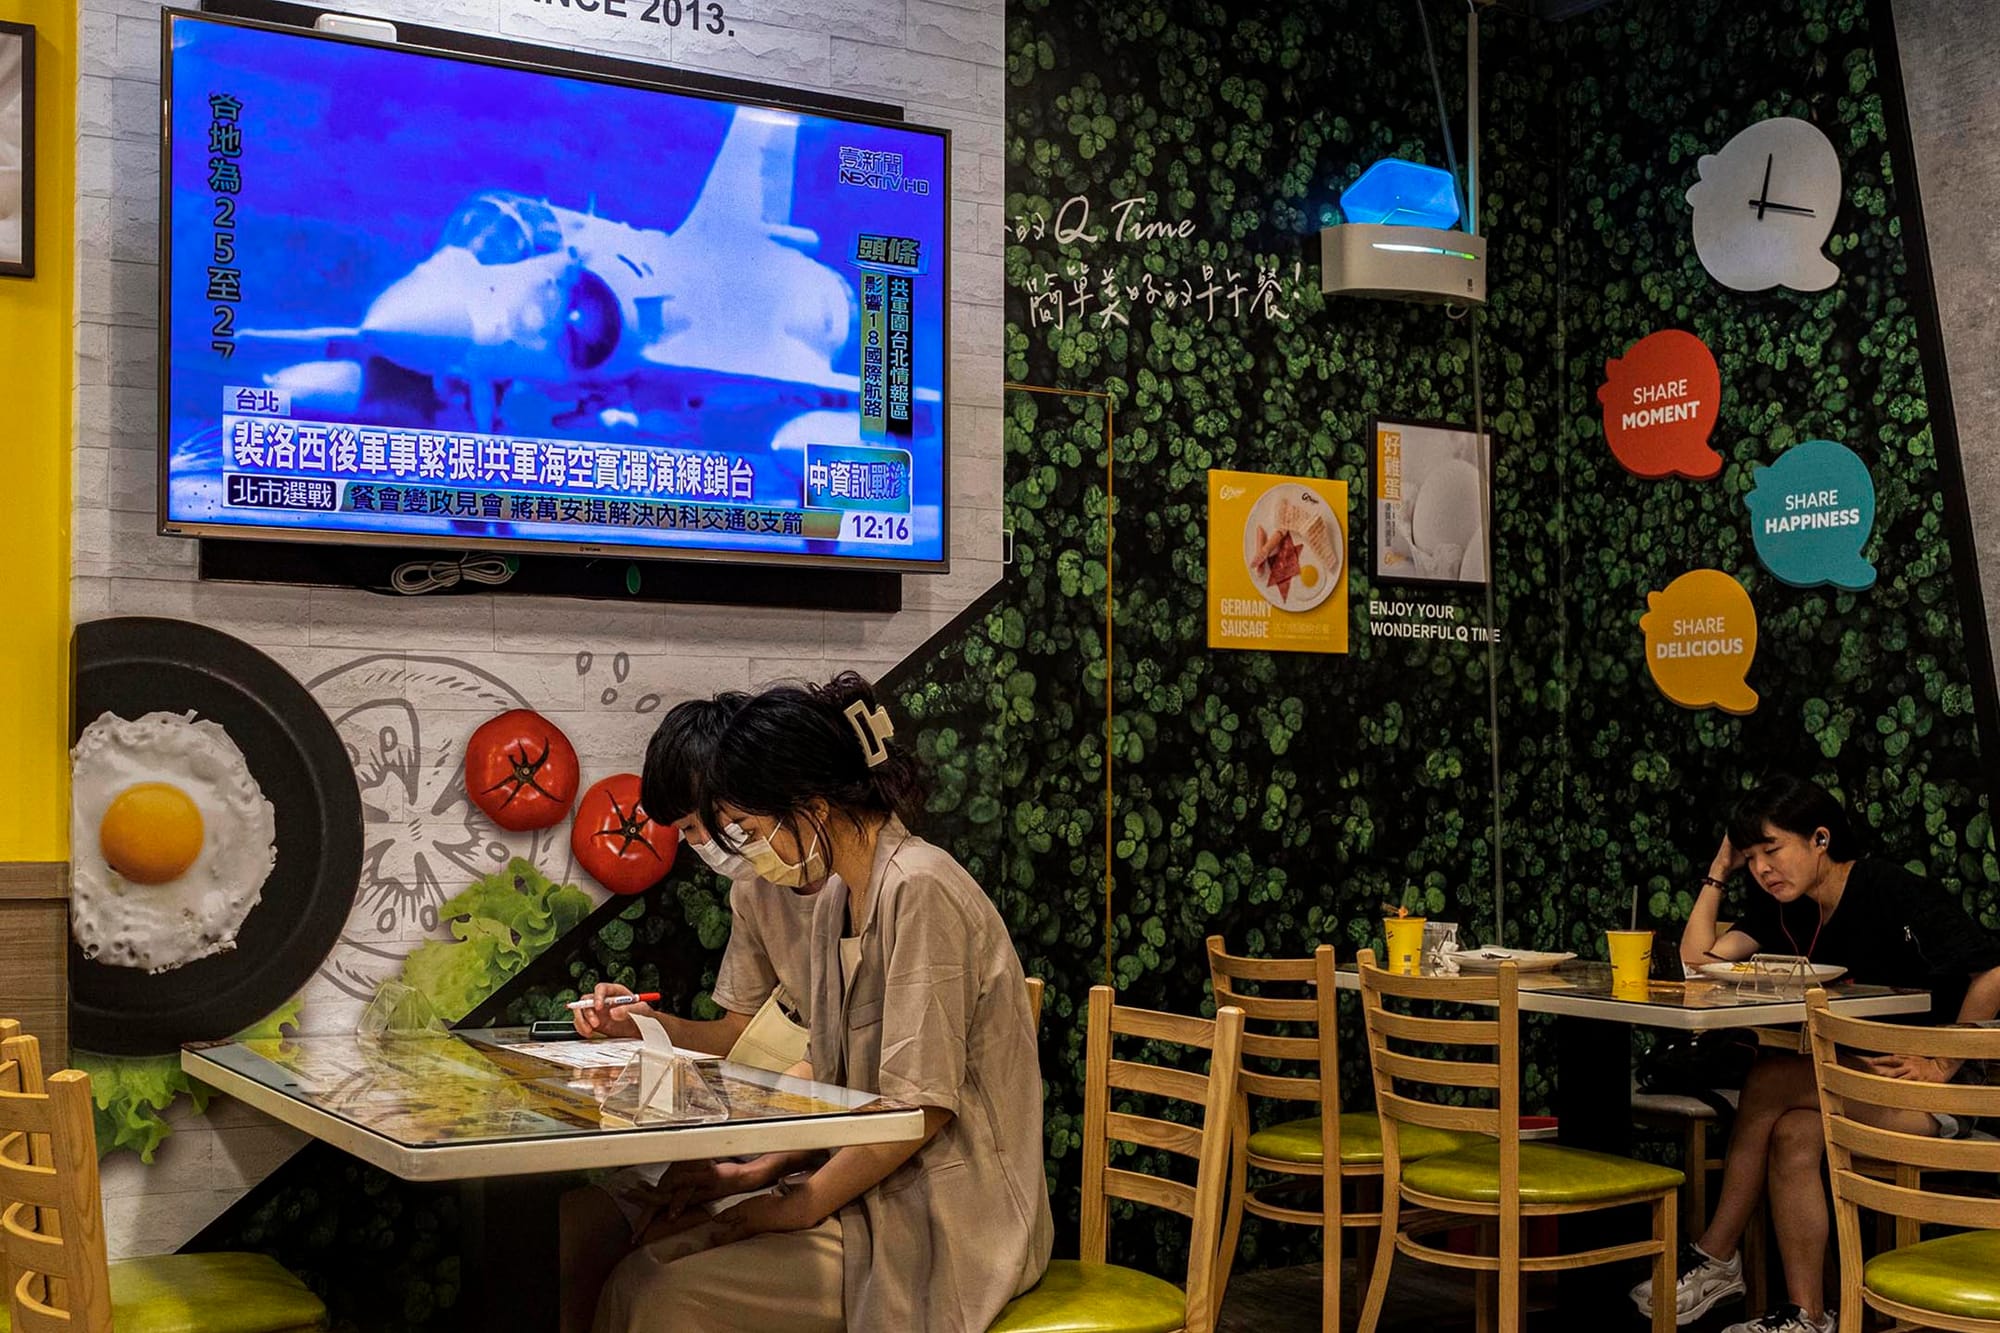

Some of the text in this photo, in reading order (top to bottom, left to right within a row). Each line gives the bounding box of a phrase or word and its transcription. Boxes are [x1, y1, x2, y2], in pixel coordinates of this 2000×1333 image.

[640, 0, 735, 37] 2013.
[840, 147, 903, 176] 壹新聞
[903, 178, 929, 196] HD
[1054, 195, 1098, 244] Q
[1110, 197, 1196, 242] Time
[857, 234, 920, 266] 頭條
[236, 389, 279, 413] 台北
[1633, 379, 1688, 405] SHARE
[1622, 401, 1700, 430] MOMENT
[234, 480, 332, 508] 北市選戰
[1785, 489, 1839, 511] SHARE
[852, 514, 909, 541] 12:16
[1765, 508, 1860, 534] HAPPINESS
[1220, 599, 1272, 618] GERMANY
[1369, 600, 1455, 620] ENJOY YOUR
[1220, 621, 1269, 639] SAUSAGE
[1370, 621, 1455, 641] WONDERFUL
[1455, 626, 1469, 643] Q
[1673, 616, 1725, 637] SHARE
[1656, 638, 1744, 660] DELICIOUS
